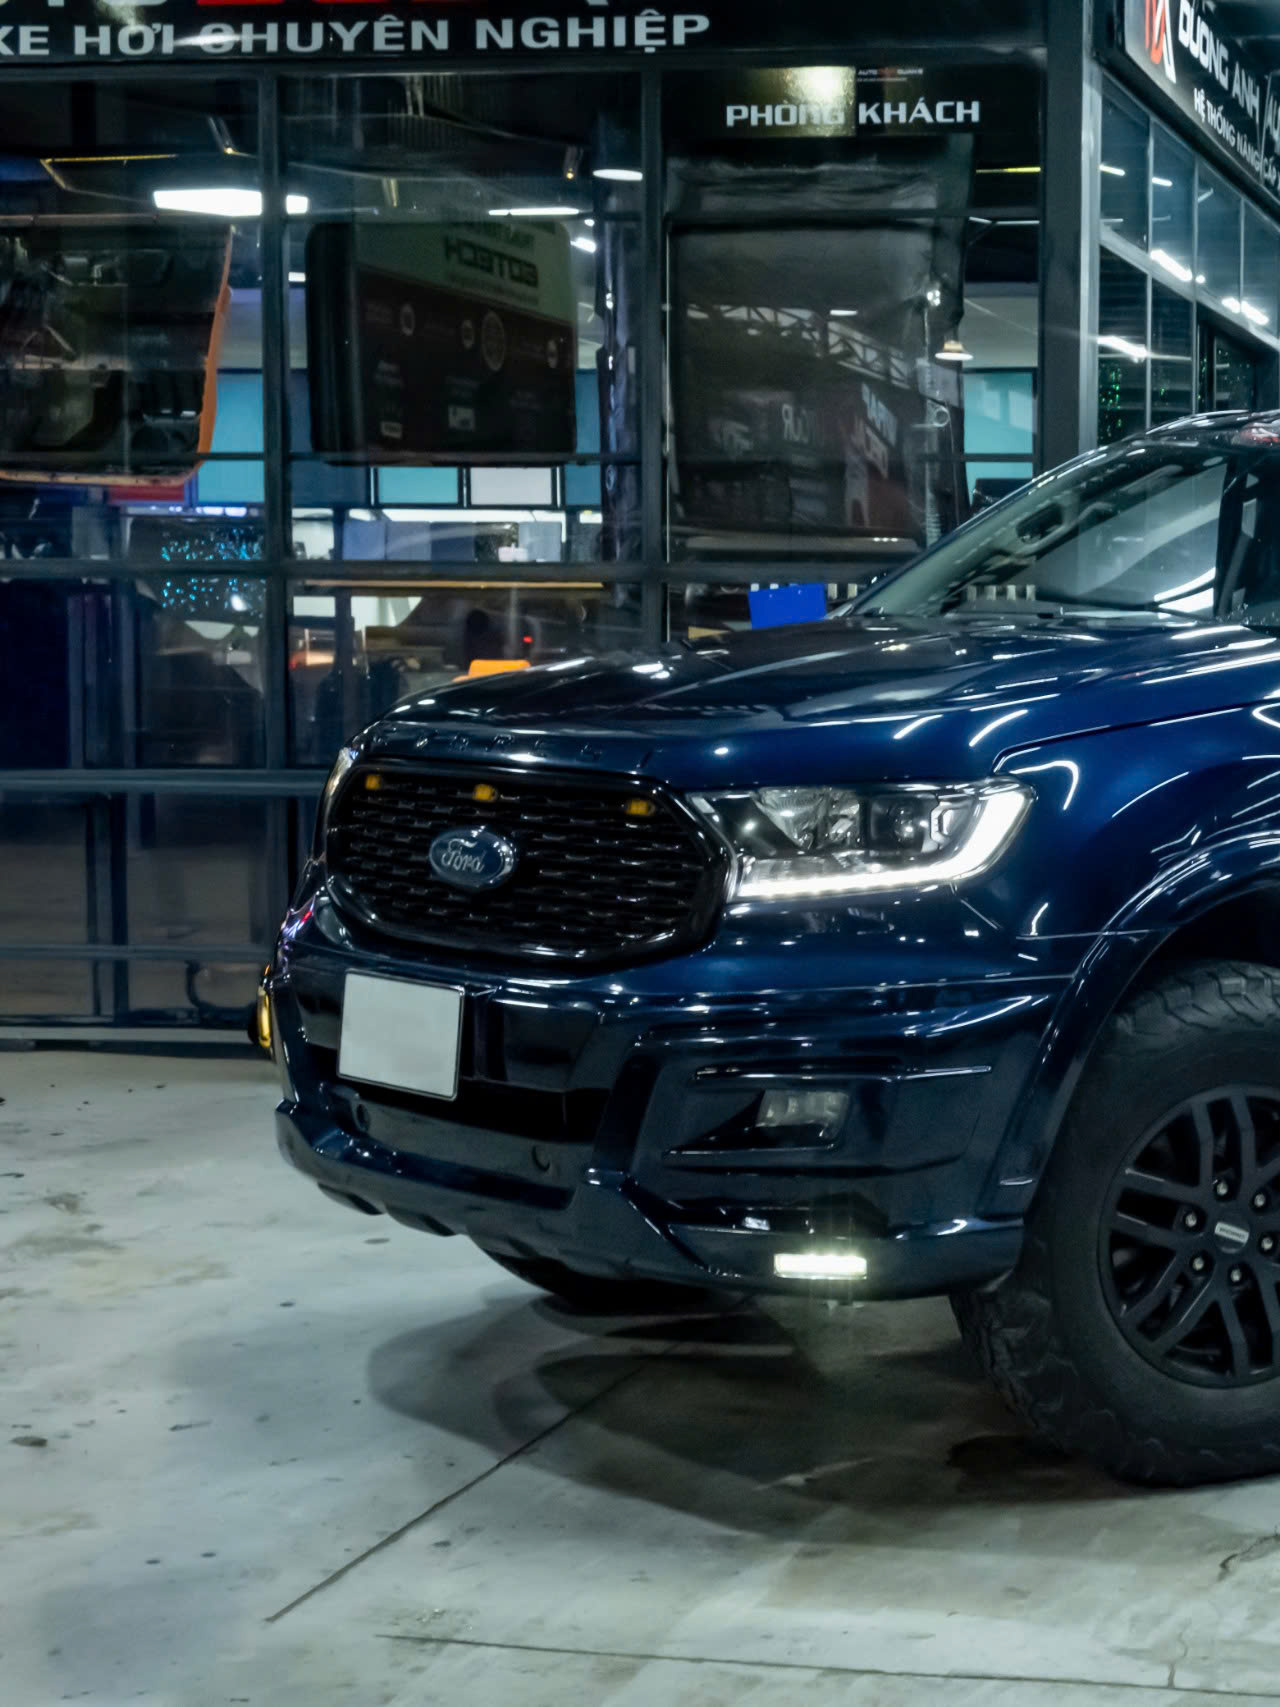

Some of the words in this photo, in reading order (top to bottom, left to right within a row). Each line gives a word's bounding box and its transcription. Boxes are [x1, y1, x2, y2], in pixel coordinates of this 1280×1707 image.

[74, 22, 174, 56] HƠI
[199, 12, 449, 55] CHUYÊN
[476, 9, 710, 53] NGHIỆP
[726, 98, 845, 128] PHÒNG
[858, 97, 980, 125] KHÁCH
[1232, 62, 1260, 125] ANH
[440, 838, 487, 874] Ford
